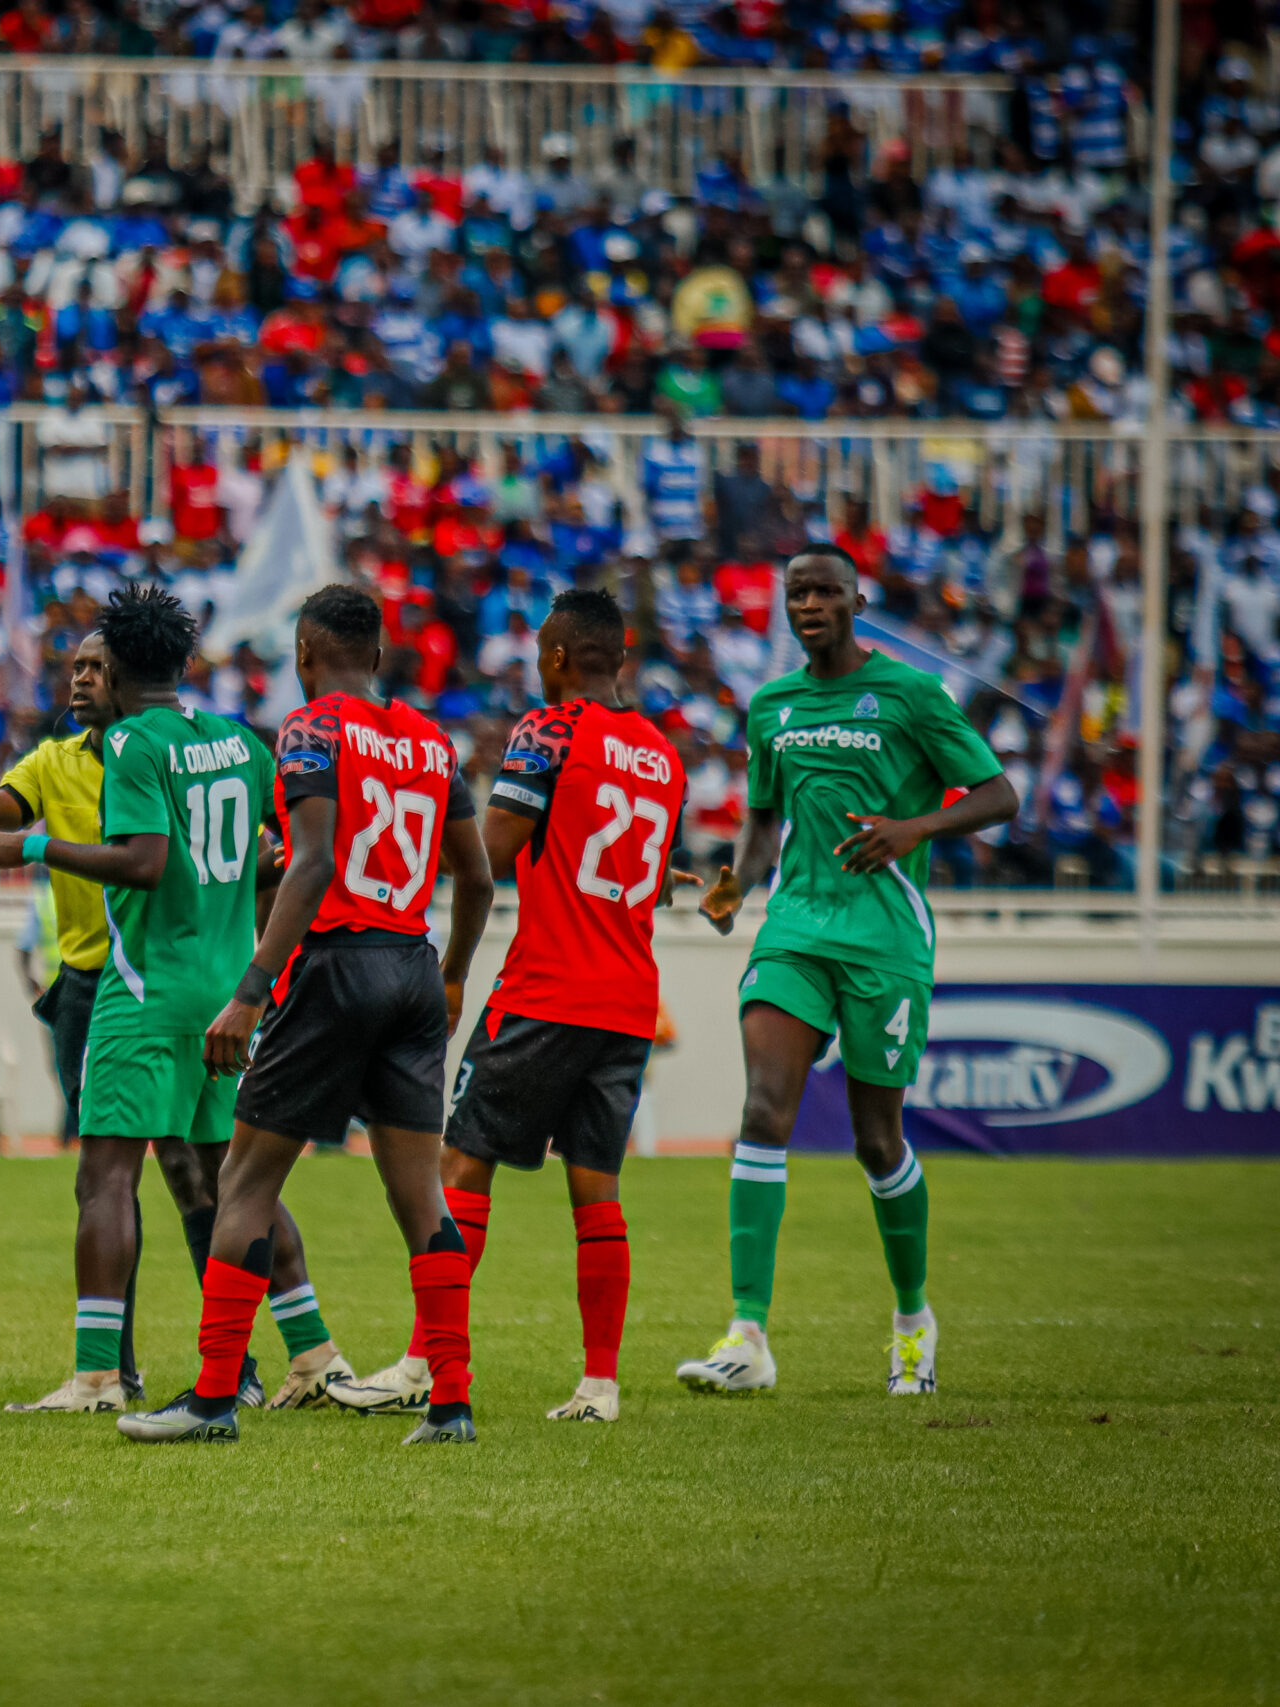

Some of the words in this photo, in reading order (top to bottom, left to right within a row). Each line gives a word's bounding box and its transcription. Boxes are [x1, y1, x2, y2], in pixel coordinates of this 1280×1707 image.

[186, 777, 250, 885] 10
[344, 777, 436, 911] 29
[576, 783, 669, 909] 23
[885, 998, 911, 1046] 4
